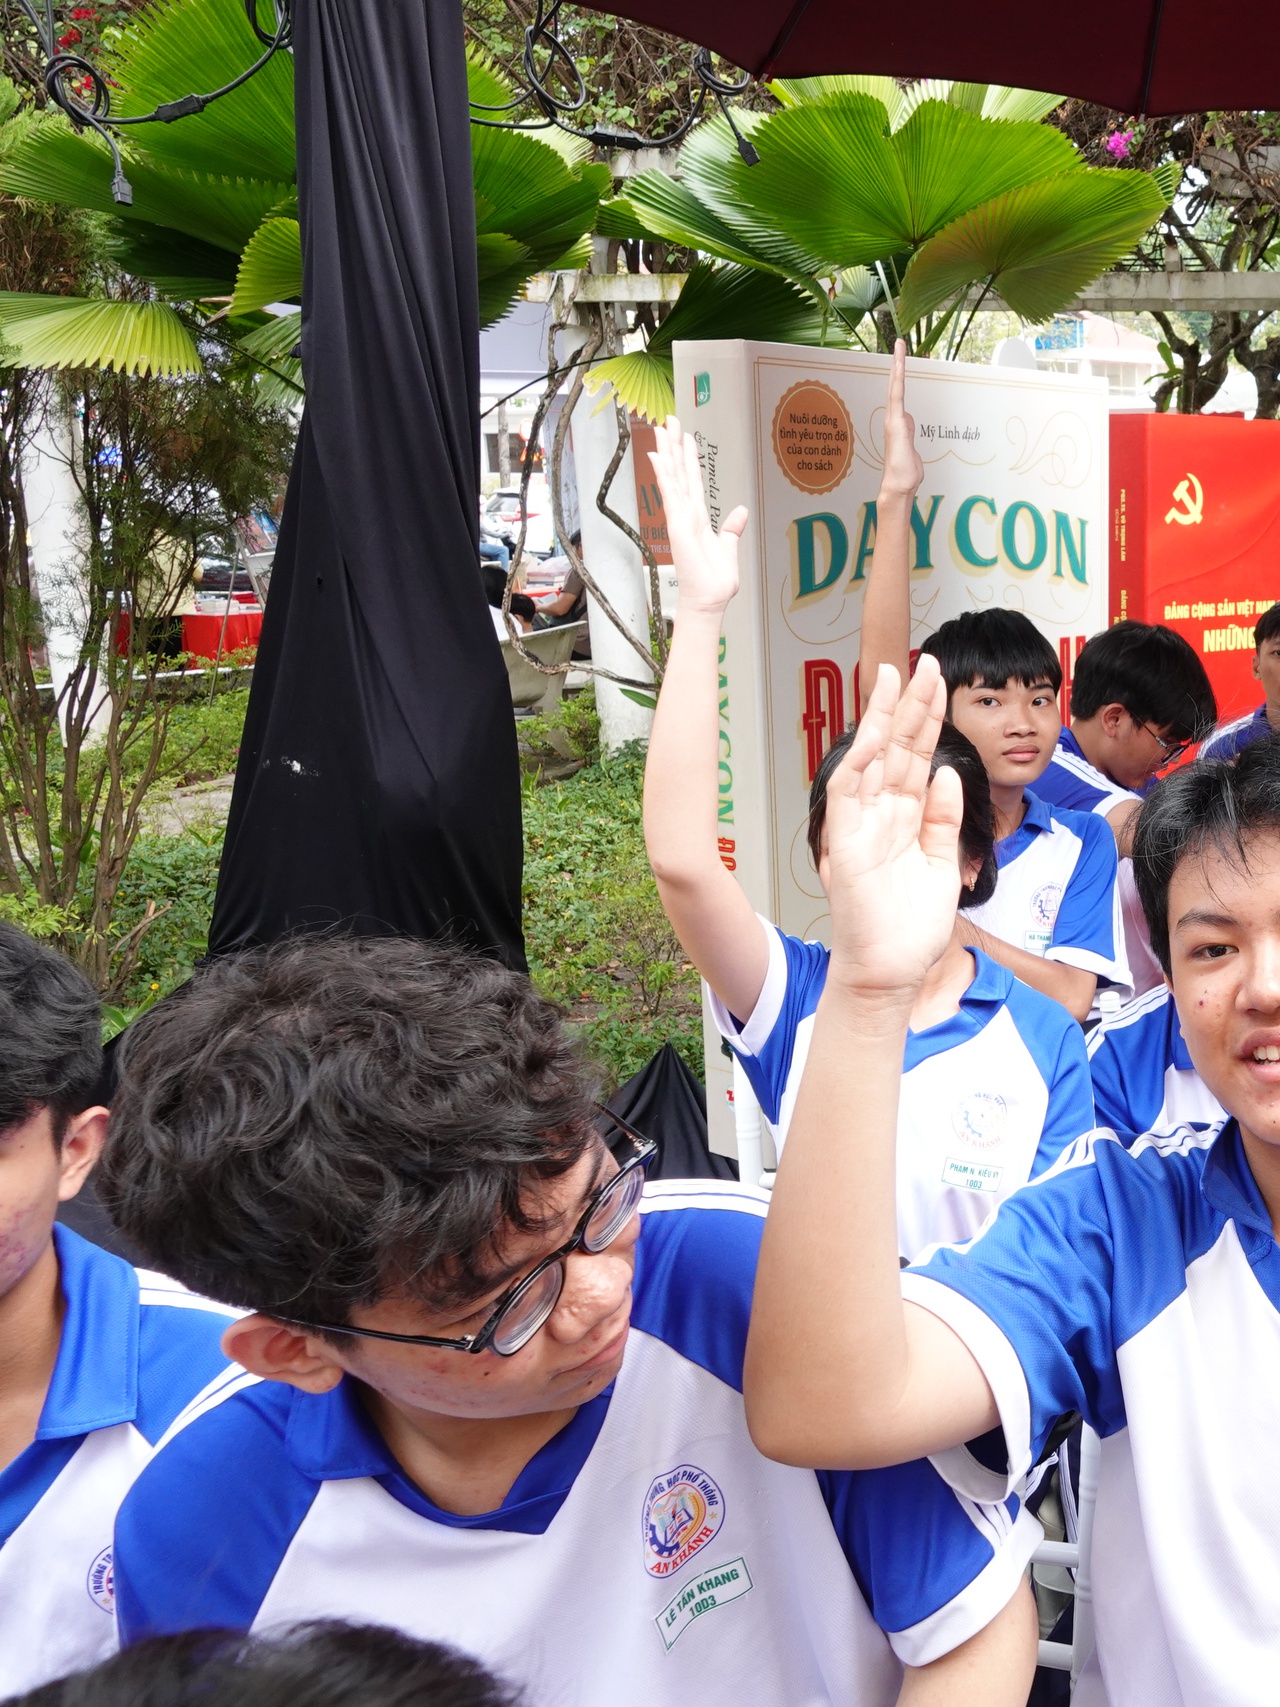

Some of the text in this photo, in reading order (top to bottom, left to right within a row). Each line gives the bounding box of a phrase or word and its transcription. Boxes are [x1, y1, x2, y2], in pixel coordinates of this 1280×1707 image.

[790, 413, 838, 429] Nuôi dưỡng
[780, 427, 797, 439] tình
[799, 428, 814, 442] yêu
[816, 431, 833, 443] trọn
[920, 424, 980, 443] Mỹ Linh dịch
[787, 443, 842, 456] của con dành
[707, 443, 721, 500] Pamela
[797, 459, 833, 471] cho sách
[953, 494, 1090, 586] CON
[1164, 601, 1190, 621] ĐẢNG
[1191, 601, 1216, 621] CỘNG
[1217, 598, 1235, 617] SẢN
[1236, 598, 1255, 618] VIỆT
[681, 1470, 703, 1483] PHỔ
[697, 1479, 718, 1507] THÔNG
[650, 1525, 714, 1574] AN KHÁNH
[696, 1568, 740, 1595] KHANG
[689, 1594, 717, 1617] 10D3
